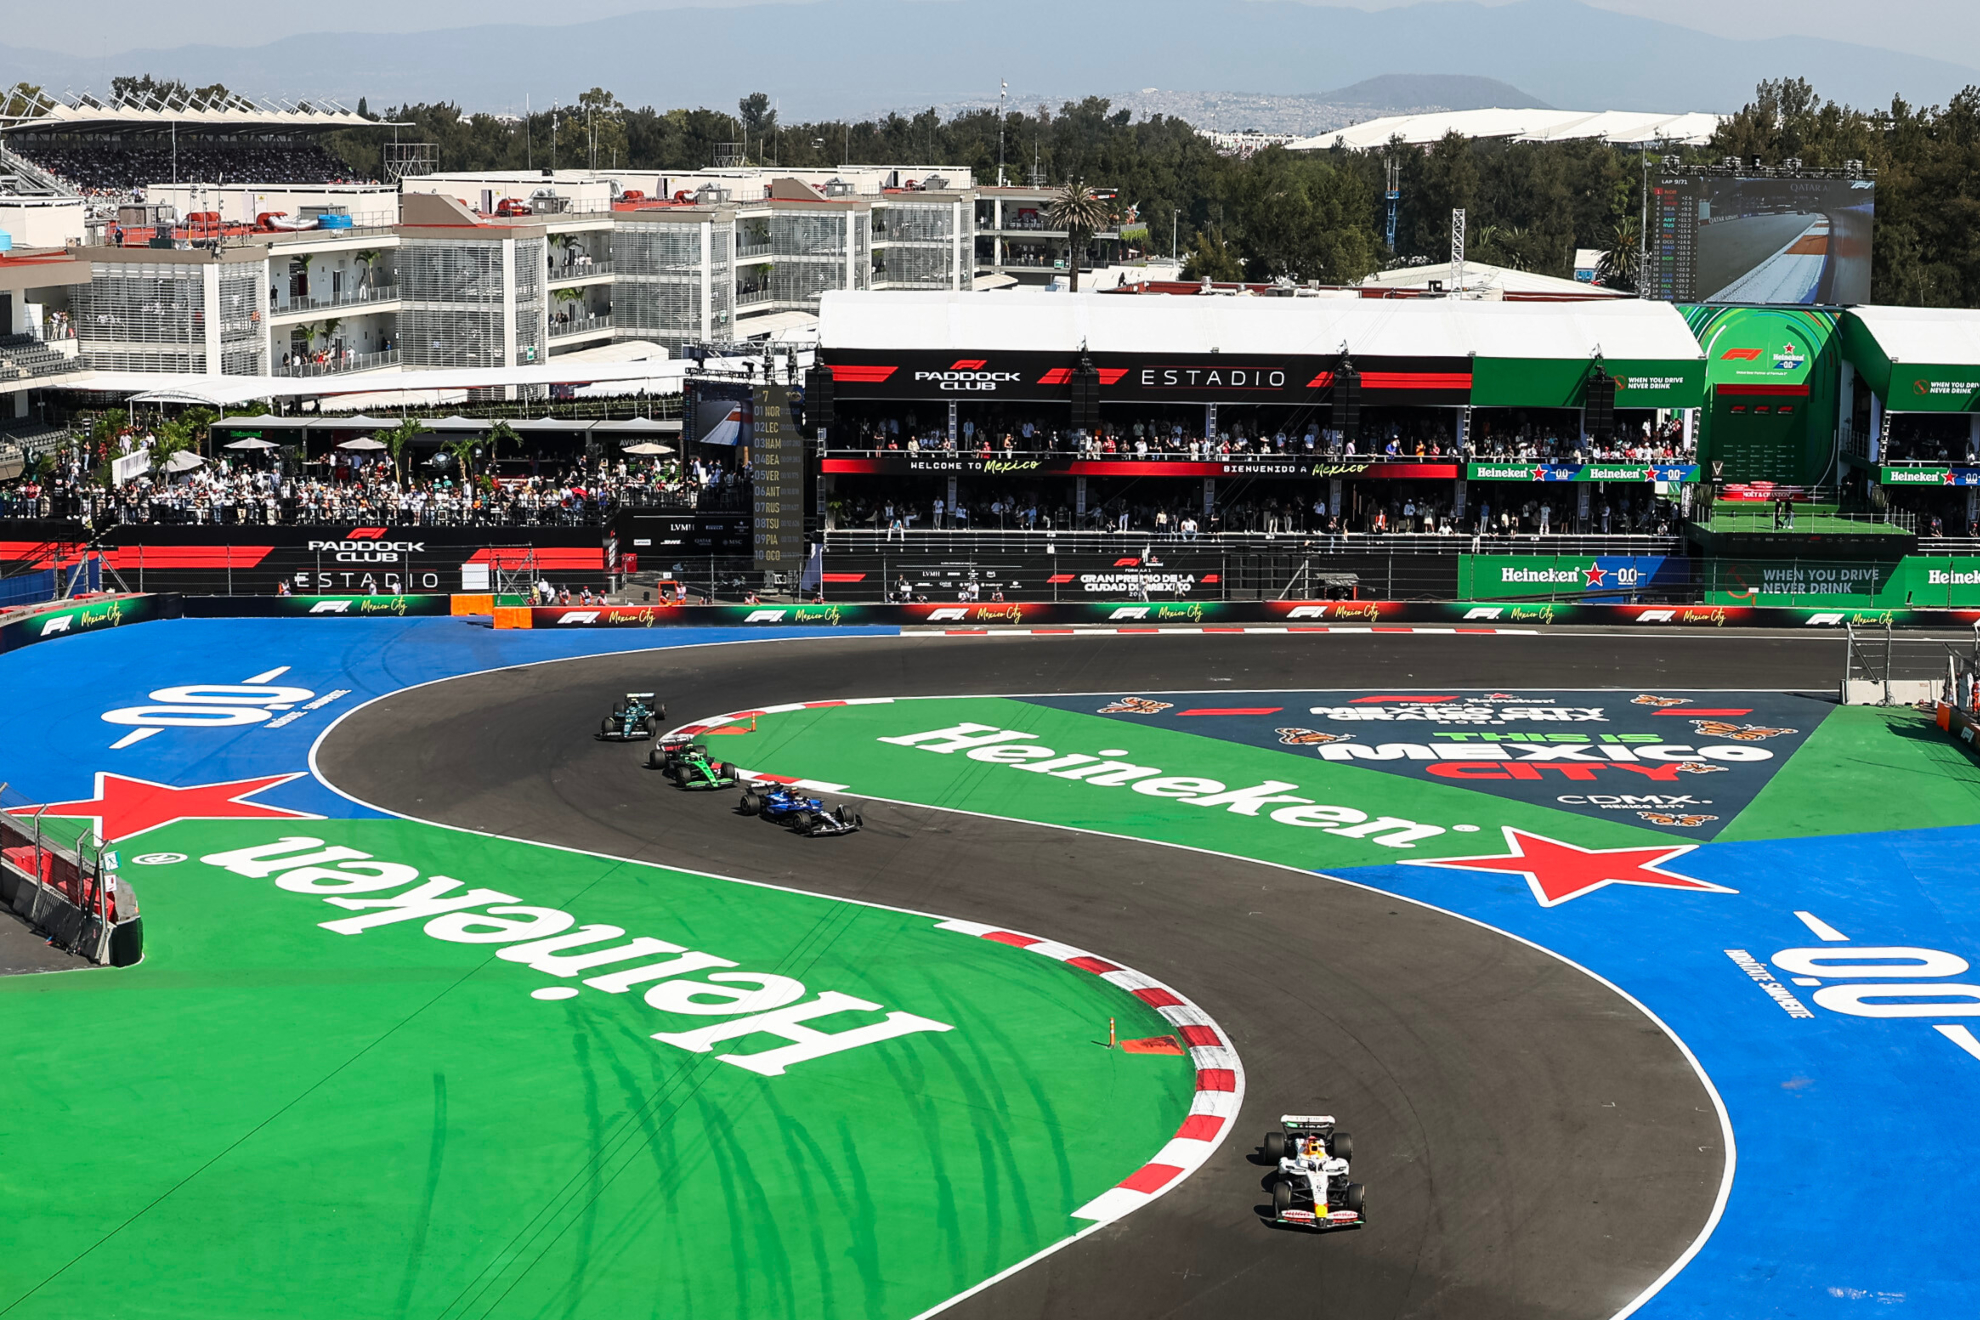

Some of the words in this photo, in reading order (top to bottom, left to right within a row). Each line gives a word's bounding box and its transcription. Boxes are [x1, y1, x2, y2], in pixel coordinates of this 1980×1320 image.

[1790, 183, 1820, 191] QATAR
[1709, 216, 1724, 224] QATAR
[1720, 348, 1763, 360] F1
[950, 359, 987, 370] F1
[915, 371, 1020, 381] PADDOCK
[1141, 370, 1285, 386] ESTADIO
[940, 382, 996, 391] CLUB
[763, 390, 768, 402] 7
[754, 406, 763, 416] 01
[765, 406, 780, 417] NOR
[754, 422, 765, 432] 02
[766, 422, 779, 433] LEC
[754, 438, 765, 448] 03
[766, 438, 781, 449] HAM
[754, 454, 766, 464] 04
[766, 454, 780, 465] BEA
[984, 460, 1042, 474] Mexico
[1223, 465, 1295, 473] BIENVENIDO
[1312, 463, 1369, 478] Mexico
[1477, 467, 1527, 478] Heineken
[1590, 467, 1640, 478] Heineken
[755, 470, 765, 480] 05
[766, 471, 779, 481] VER
[1891, 471, 1939, 482] Heineken
[755, 486, 765, 496] 06
[766, 486, 780, 497] ANT
[755, 502, 765, 512] 07
[766, 503, 780, 513] RUS
[755, 518, 766, 528] 08
[766, 518, 779, 529] TSU
[346, 528, 388, 539] F1
[755, 534, 765, 544] 09
[766, 534, 778, 545] PIA
[308, 541, 425, 551] PADDOCK
[336, 552, 398, 562] CLUB
[755, 550, 764, 560] 10
[766, 550, 780, 560] OCO
[1113, 558, 1142, 566] F1
[296, 573, 438, 588] ESTADIO
[1080, 574, 1116, 583] GRAN
[1162, 575, 1177, 583] DE
[1501, 568, 1578, 582] Heineken
[1618, 568, 1638, 582] 0.0
[1763, 569, 1801, 581] WHEN
[1808, 570, 1836, 581] YOU
[1840, 569, 1879, 580] DRIVE
[1084, 583, 1127, 591] CIUDAD
[1763, 583, 1806, 594] NEVER
[1809, 583, 1852, 594] DRINK
[309, 601, 353, 613] F1
[361, 600, 389, 613] Mexico
[391, 596, 407, 615] City
[744, 610, 787, 622] F1
[795, 609, 823, 622] Mexico
[824, 605, 840, 625] City
[926, 608, 969, 620] F1
[977, 607, 1005, 620] Mexico
[1006, 604, 1022, 624] City
[1109, 607, 1151, 619] F1
[1158, 606, 1186, 619] Mexico
[1187, 603, 1203, 622] City
[1286, 606, 1328, 618] F1
[1335, 605, 1362, 619] Mexico
[1364, 602, 1380, 622] City
[1463, 607, 1504, 619] F1
[1511, 607, 1538, 620] Mexico
[1539, 605, 1554, 624] City
[1636, 610, 1676, 622] F1
[1683, 610, 1709, 622] Mexico
[1711, 607, 1726, 626] City
[1805, 613, 1845, 625] F1
[1852, 613, 1878, 624] Mexico
[1879, 610, 1894, 624] City
[40, 614, 74, 636] F1
[81, 611, 106, 627] Mexico
[107, 602, 122, 626] City
[557, 611, 600, 624] F1
[609, 611, 638, 624] Mexico
[639, 608, 655, 628] City
[101, 684, 315, 726] 0.0
[1432, 732, 1591, 743] THIS
[1599, 733, 1663, 743] IS
[1317, 743, 1774, 762] MEXICO
[1425, 762, 1685, 781] CITY
[877, 722, 1446, 849] Heineken
[200, 836, 954, 1076] Heineken
[1771, 947, 1980, 1018] 0.0
